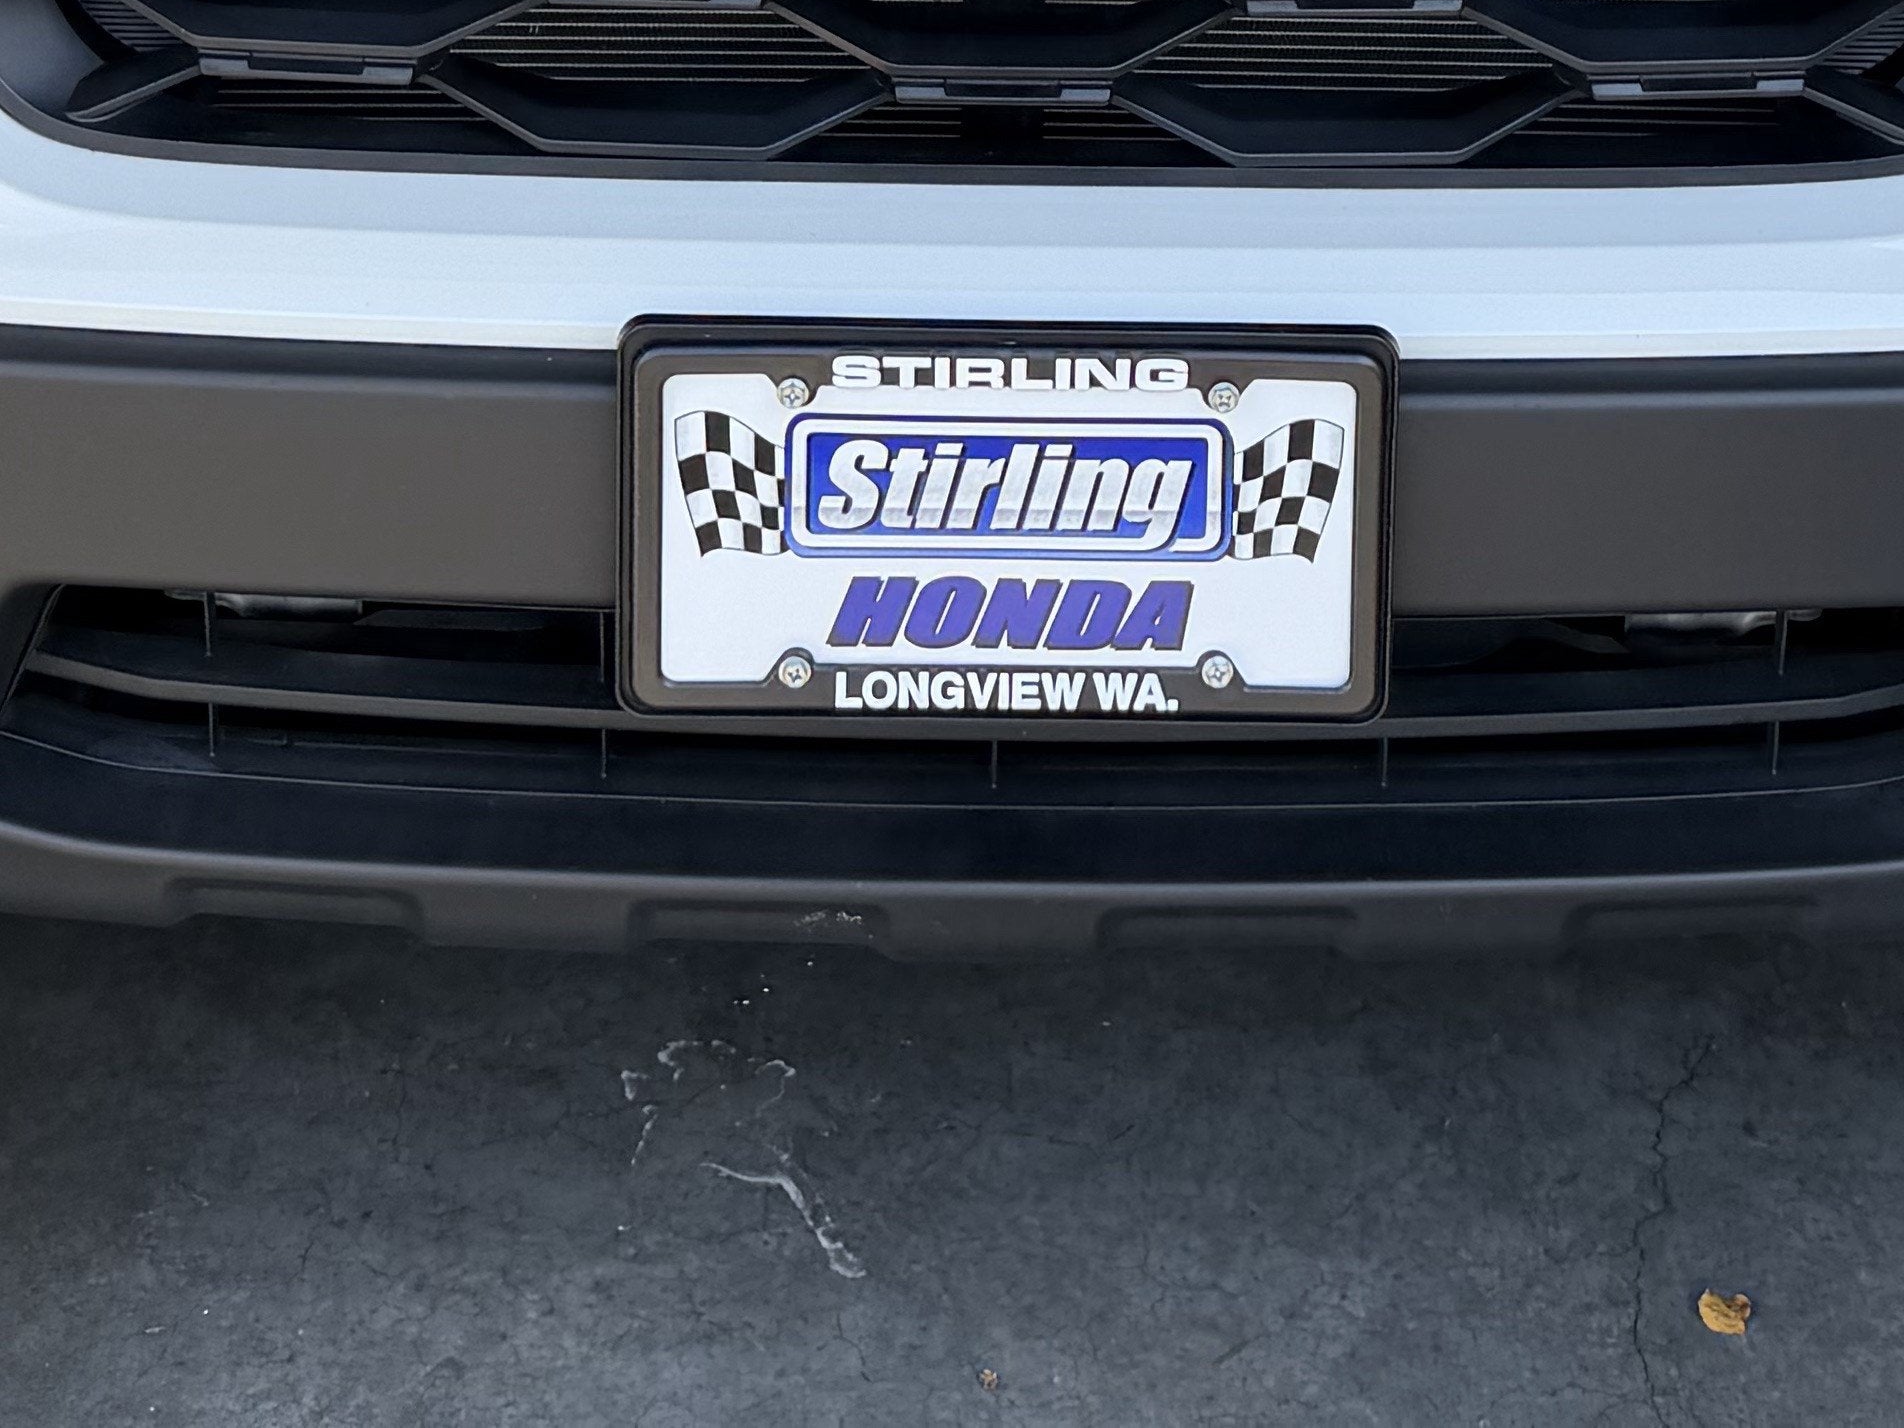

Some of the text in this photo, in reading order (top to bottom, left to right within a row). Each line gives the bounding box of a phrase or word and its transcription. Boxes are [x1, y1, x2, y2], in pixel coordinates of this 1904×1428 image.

[831, 354, 1190, 391] STIRLING
[818, 439, 1197, 551] Stirling
[826, 576, 1195, 652] HONDA
[833, 670, 1180, 714] LONGVIEW WA.
